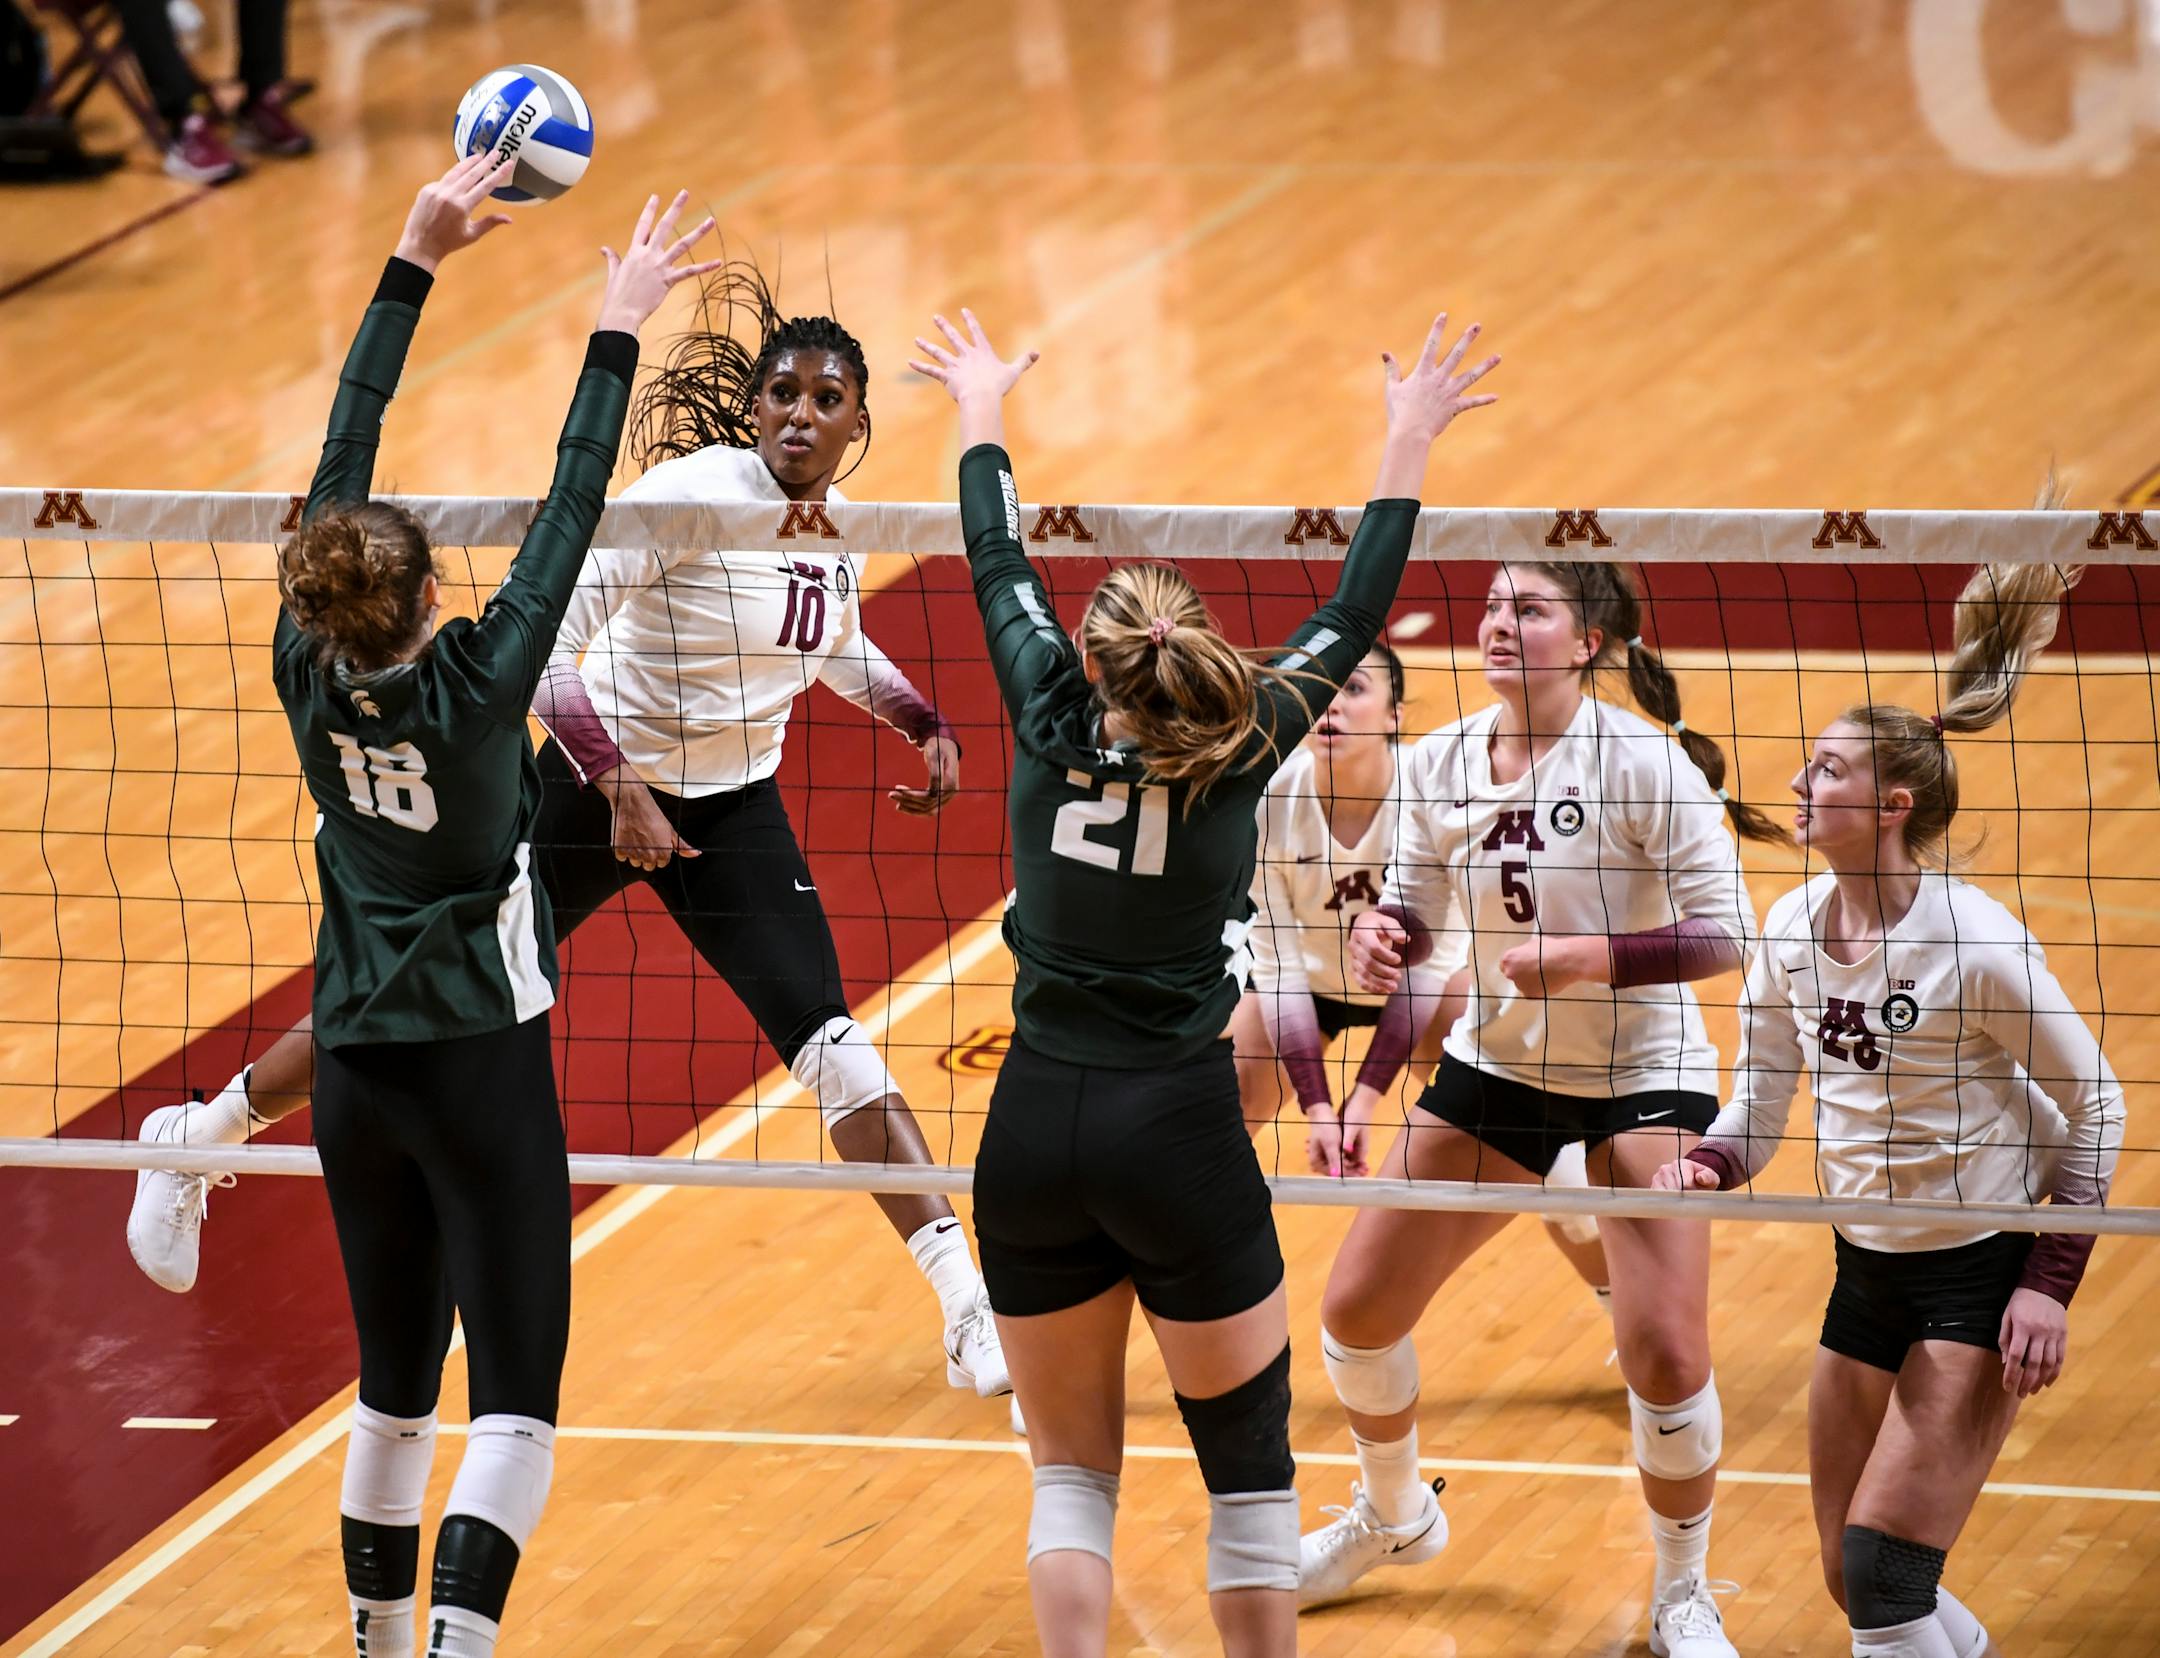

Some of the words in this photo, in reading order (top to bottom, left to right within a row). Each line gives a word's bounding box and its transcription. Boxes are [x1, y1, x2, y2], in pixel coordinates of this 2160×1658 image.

[34, 491, 97, 529] M
[777, 502, 839, 539] M
[998, 469, 1020, 543] SPARTANS
[1029, 505, 1093, 543] M
[1284, 508, 1350, 545] M
[1545, 510, 1612, 547] M
[1813, 511, 1881, 549] M
[2087, 512, 2158, 550] M
[776, 579, 826, 652] 10
[328, 730, 439, 832] 18
[1050, 767, 1169, 876] 21
[1482, 809, 1545, 851] M
[1324, 870, 1381, 909] M
[1501, 861, 1535, 923] 5
